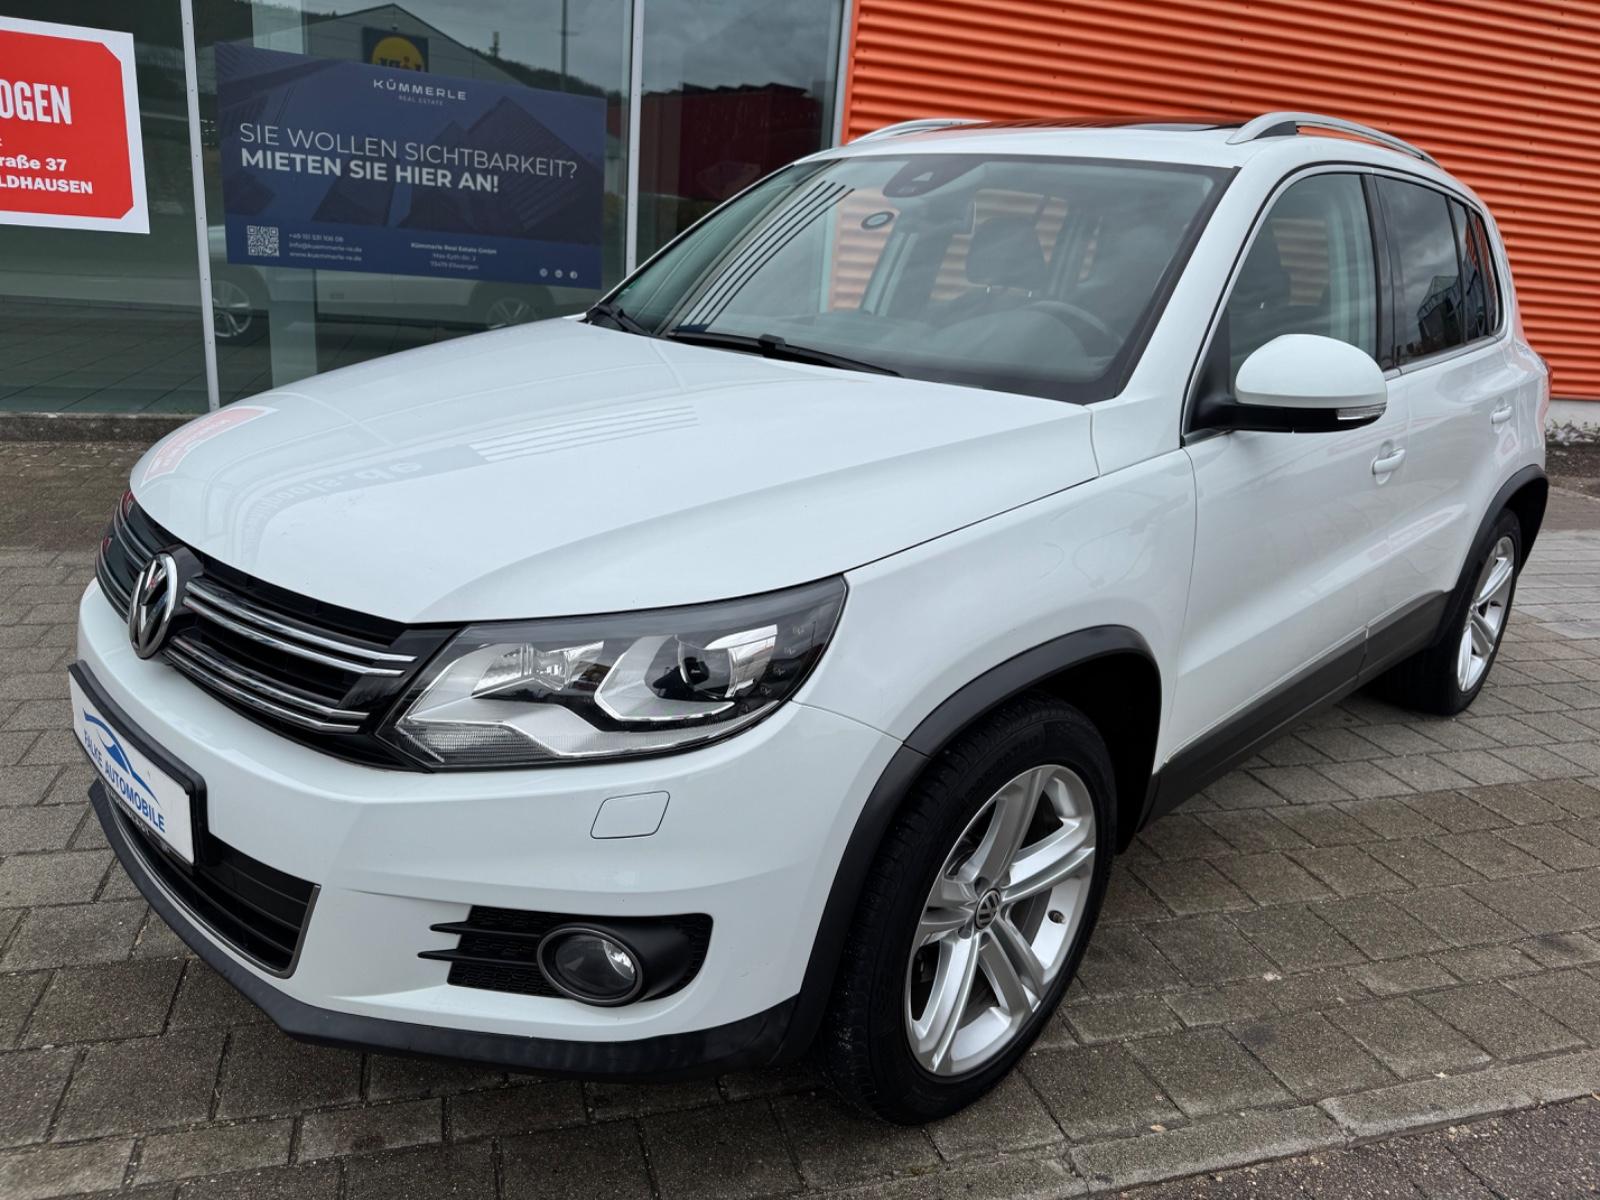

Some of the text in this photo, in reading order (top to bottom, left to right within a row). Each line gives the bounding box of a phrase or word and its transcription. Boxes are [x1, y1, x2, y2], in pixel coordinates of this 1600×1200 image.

[0, 79, 72, 125] OGEN
[373, 79, 467, 101] KÜMMERLE
[45, 157, 67, 171] 37
[240, 122, 578, 179] SIE WOLLEN SICHTBARKEIT?
[241, 147, 499, 193] MIETEN SIE HIER AN!
[105, 761, 166, 833] AUTOMOBILE
